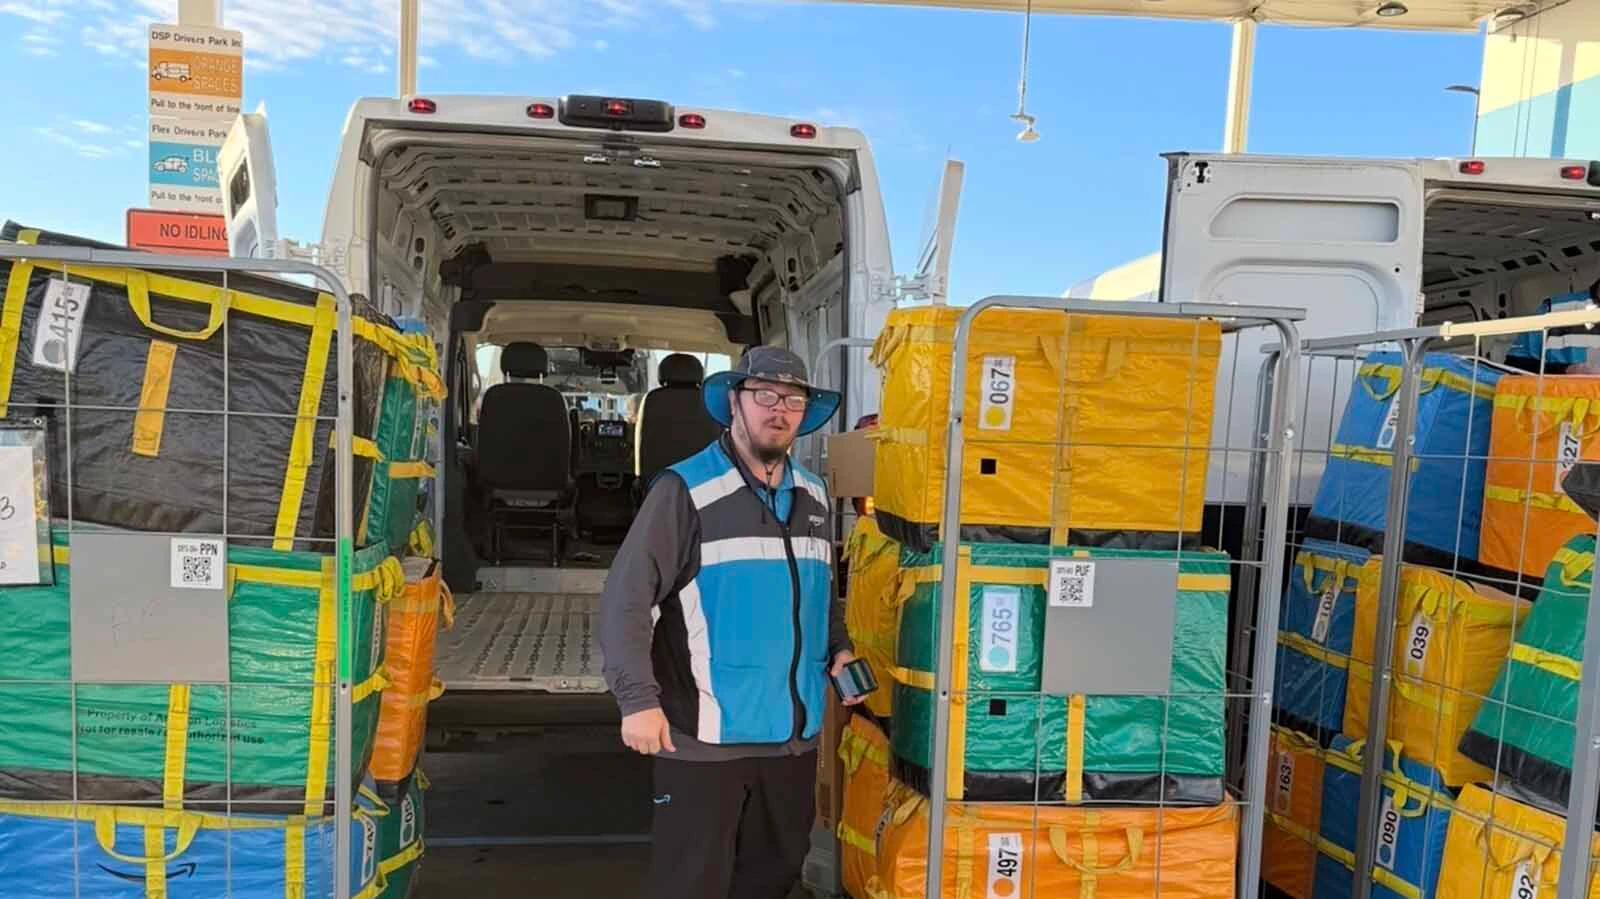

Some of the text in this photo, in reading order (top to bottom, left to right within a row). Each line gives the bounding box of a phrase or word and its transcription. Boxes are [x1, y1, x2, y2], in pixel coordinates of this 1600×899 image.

[152, 31, 171, 41] DSP
[174, 33, 205, 45] Drivers
[208, 36, 229, 47] Park
[151, 98, 240, 115] Pull to the front of line
[152, 124, 227, 138] Flex Drivers Park
[192, 148, 218, 163] BL
[151, 190, 165, 200] Pull
[168, 192, 177, 200] to
[180, 192, 191, 201] the
[160, 223, 181, 237] NO
[49, 297, 79, 340] 415
[990, 368, 1010, 404] 067
[200, 543, 217, 556] PPN
[992, 607, 1013, 645] 765
[1411, 626, 1429, 660] 039
[88, 707, 136, 721] Property
[140, 712, 152, 722] of
[99, 724, 116, 735] for
[243, 734, 265, 745] use
[1280, 764, 1292, 791] 163
[1382, 810, 1397, 844] 090
[997, 848, 1018, 877] 497
